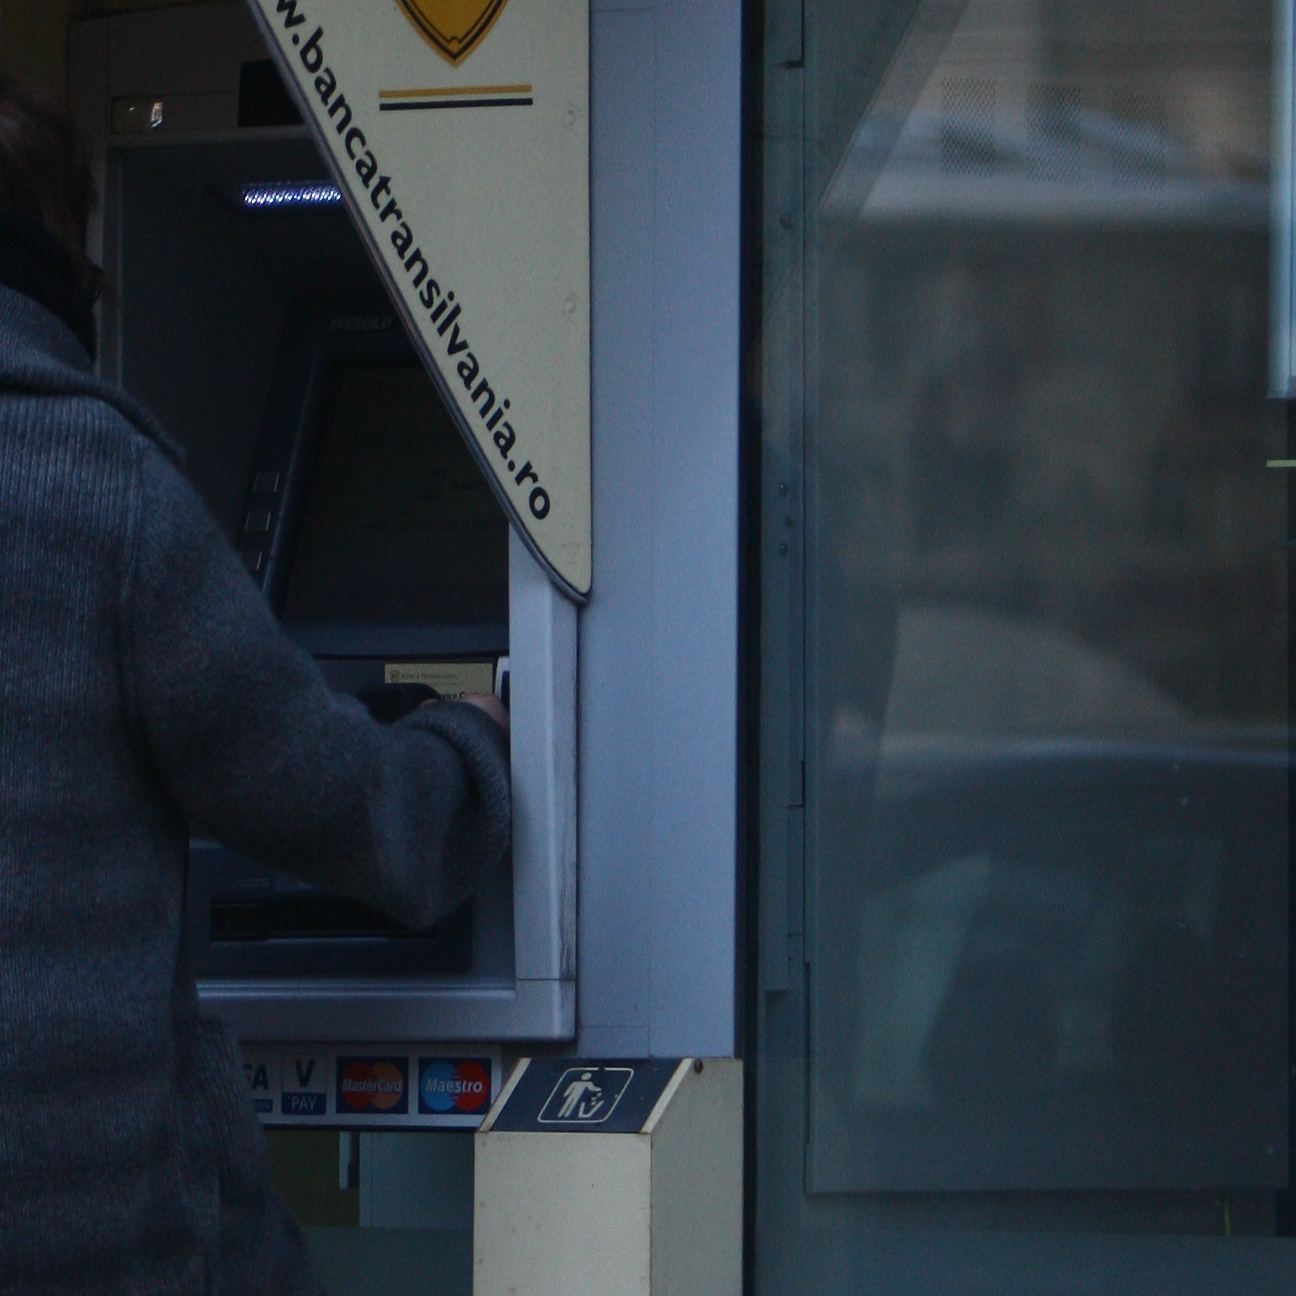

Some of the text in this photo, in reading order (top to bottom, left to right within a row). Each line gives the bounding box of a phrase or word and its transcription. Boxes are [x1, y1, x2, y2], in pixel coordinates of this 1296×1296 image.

[342, 1077, 404, 1094] MasterCard
[424, 1077, 484, 1094] Maestro
[290, 1096, 317, 1111] PAY
